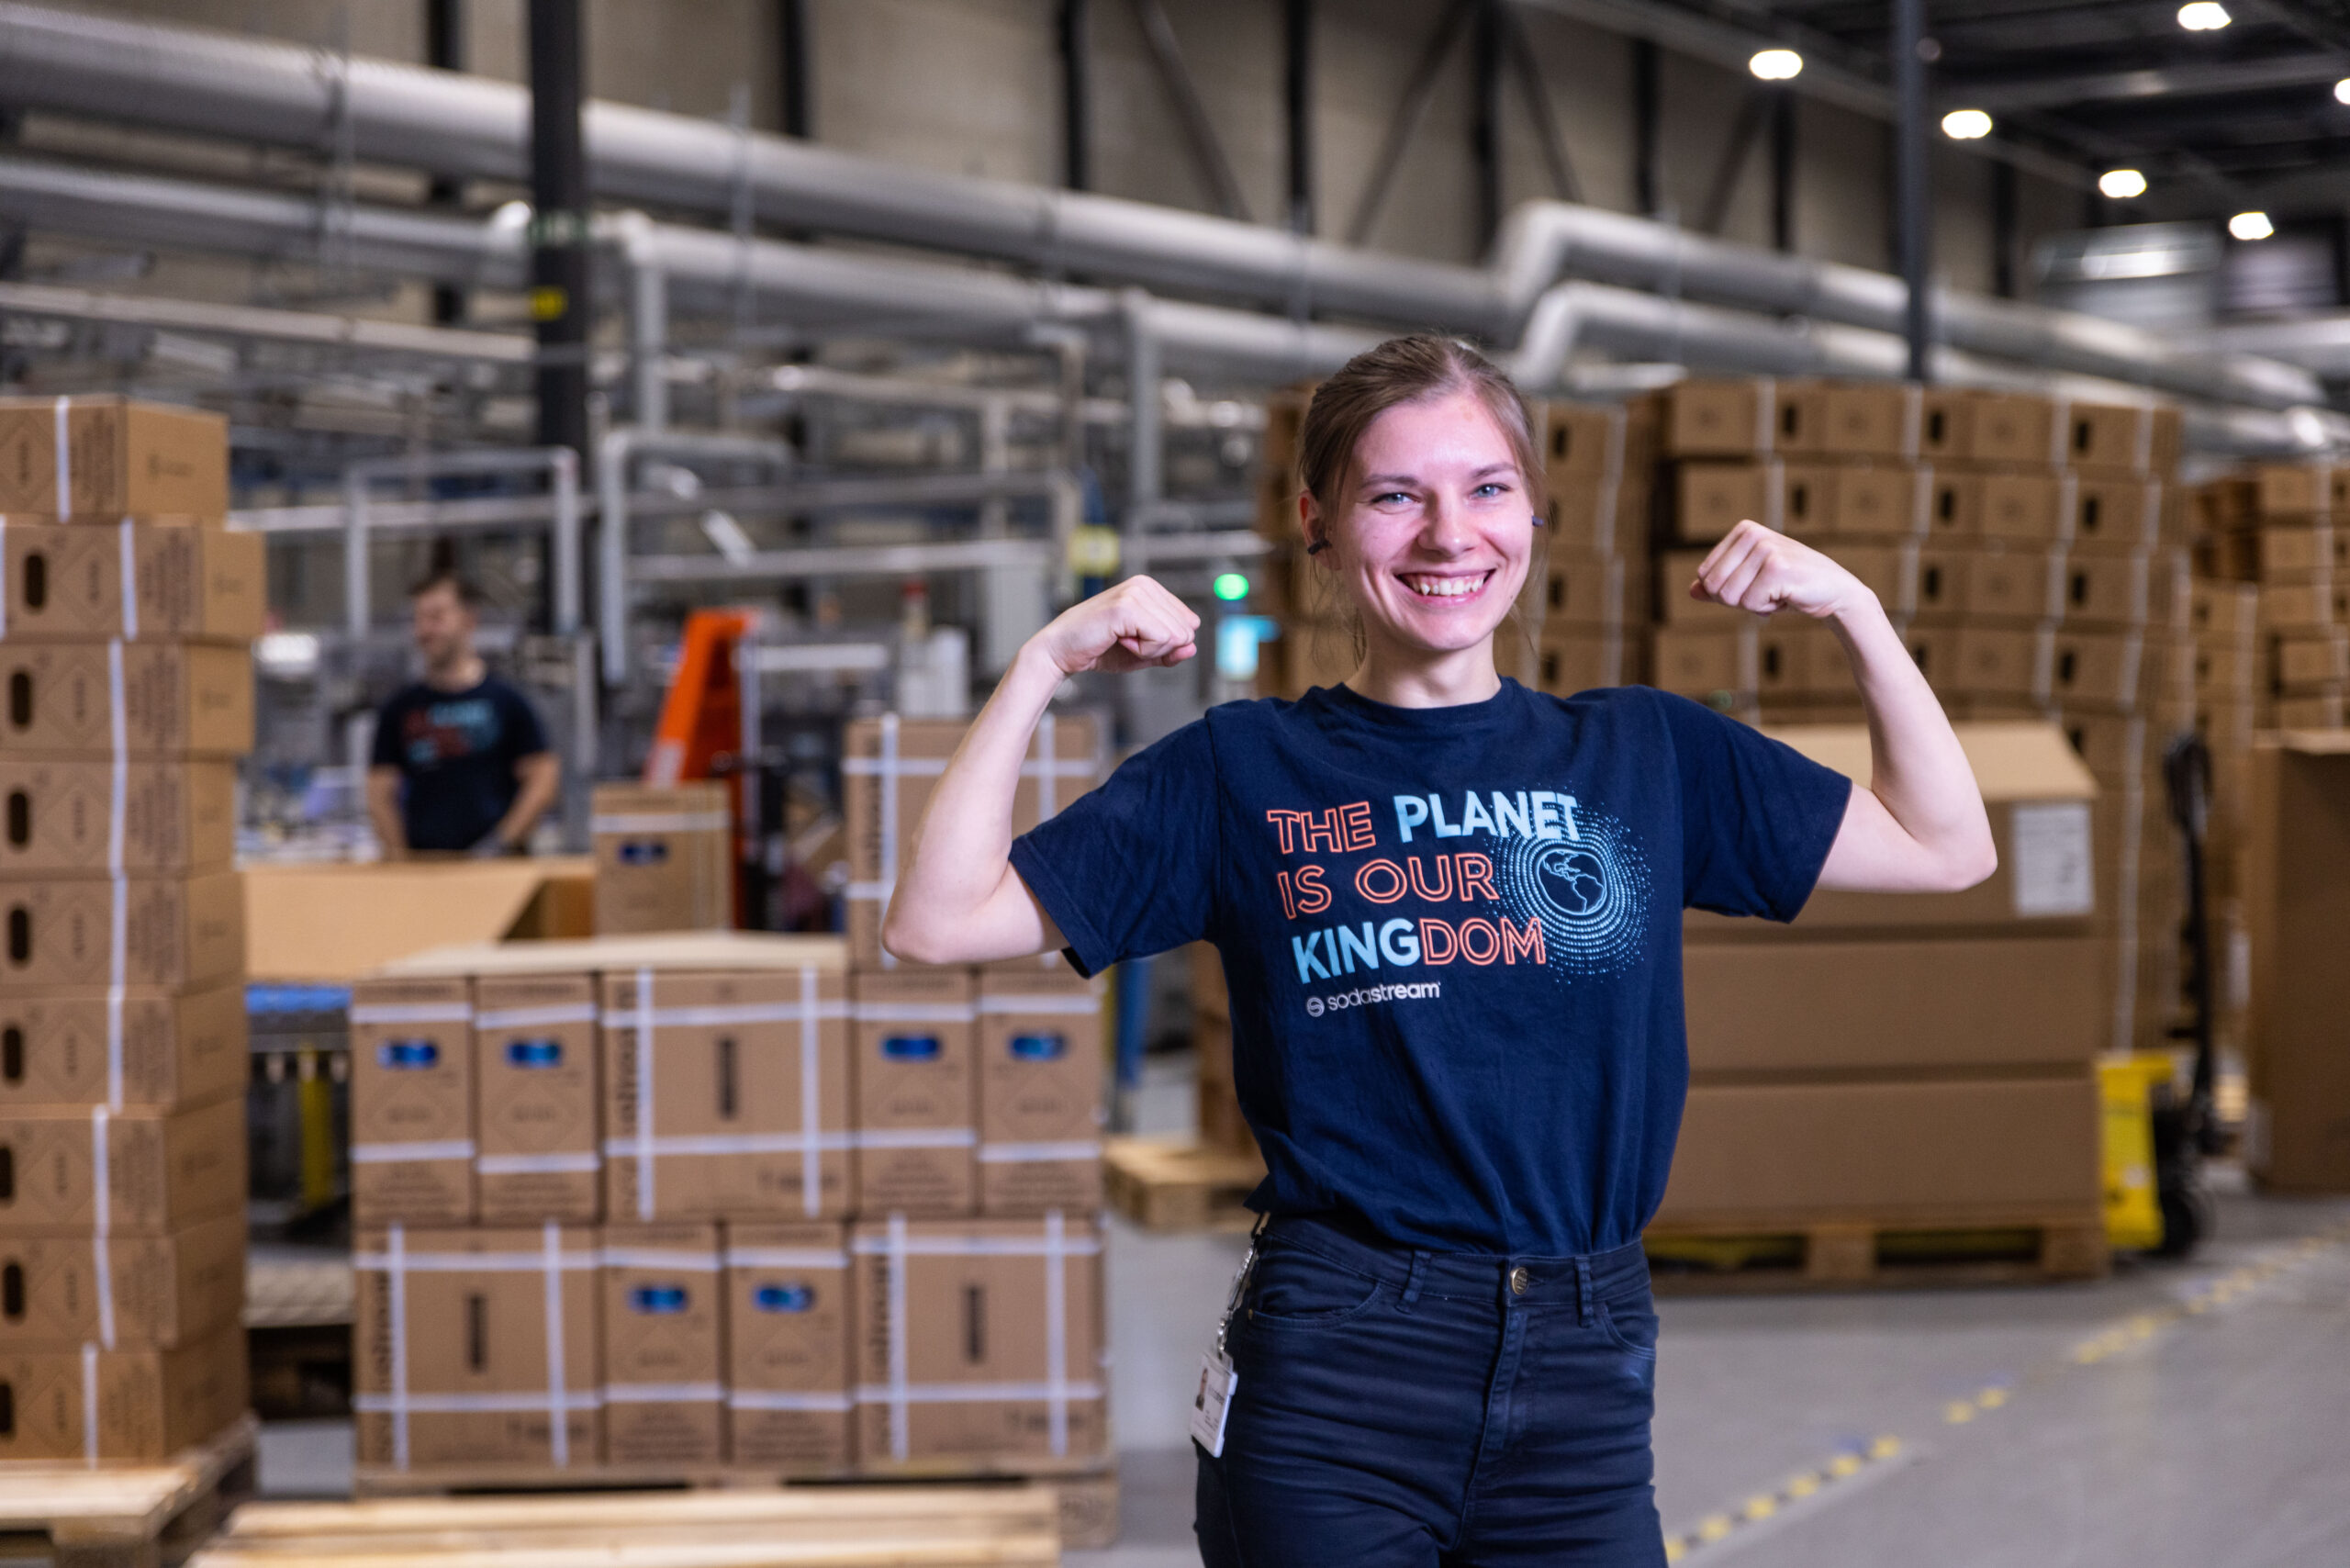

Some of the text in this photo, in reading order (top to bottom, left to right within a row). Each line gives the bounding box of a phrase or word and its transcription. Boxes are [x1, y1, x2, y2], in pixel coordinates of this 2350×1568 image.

[1267, 790, 1580, 854] THE PLANET
[1277, 853, 1499, 920] IS OUR
[1292, 918, 1546, 984] KINGDOM
[1327, 982, 1440, 1011] sodastream
